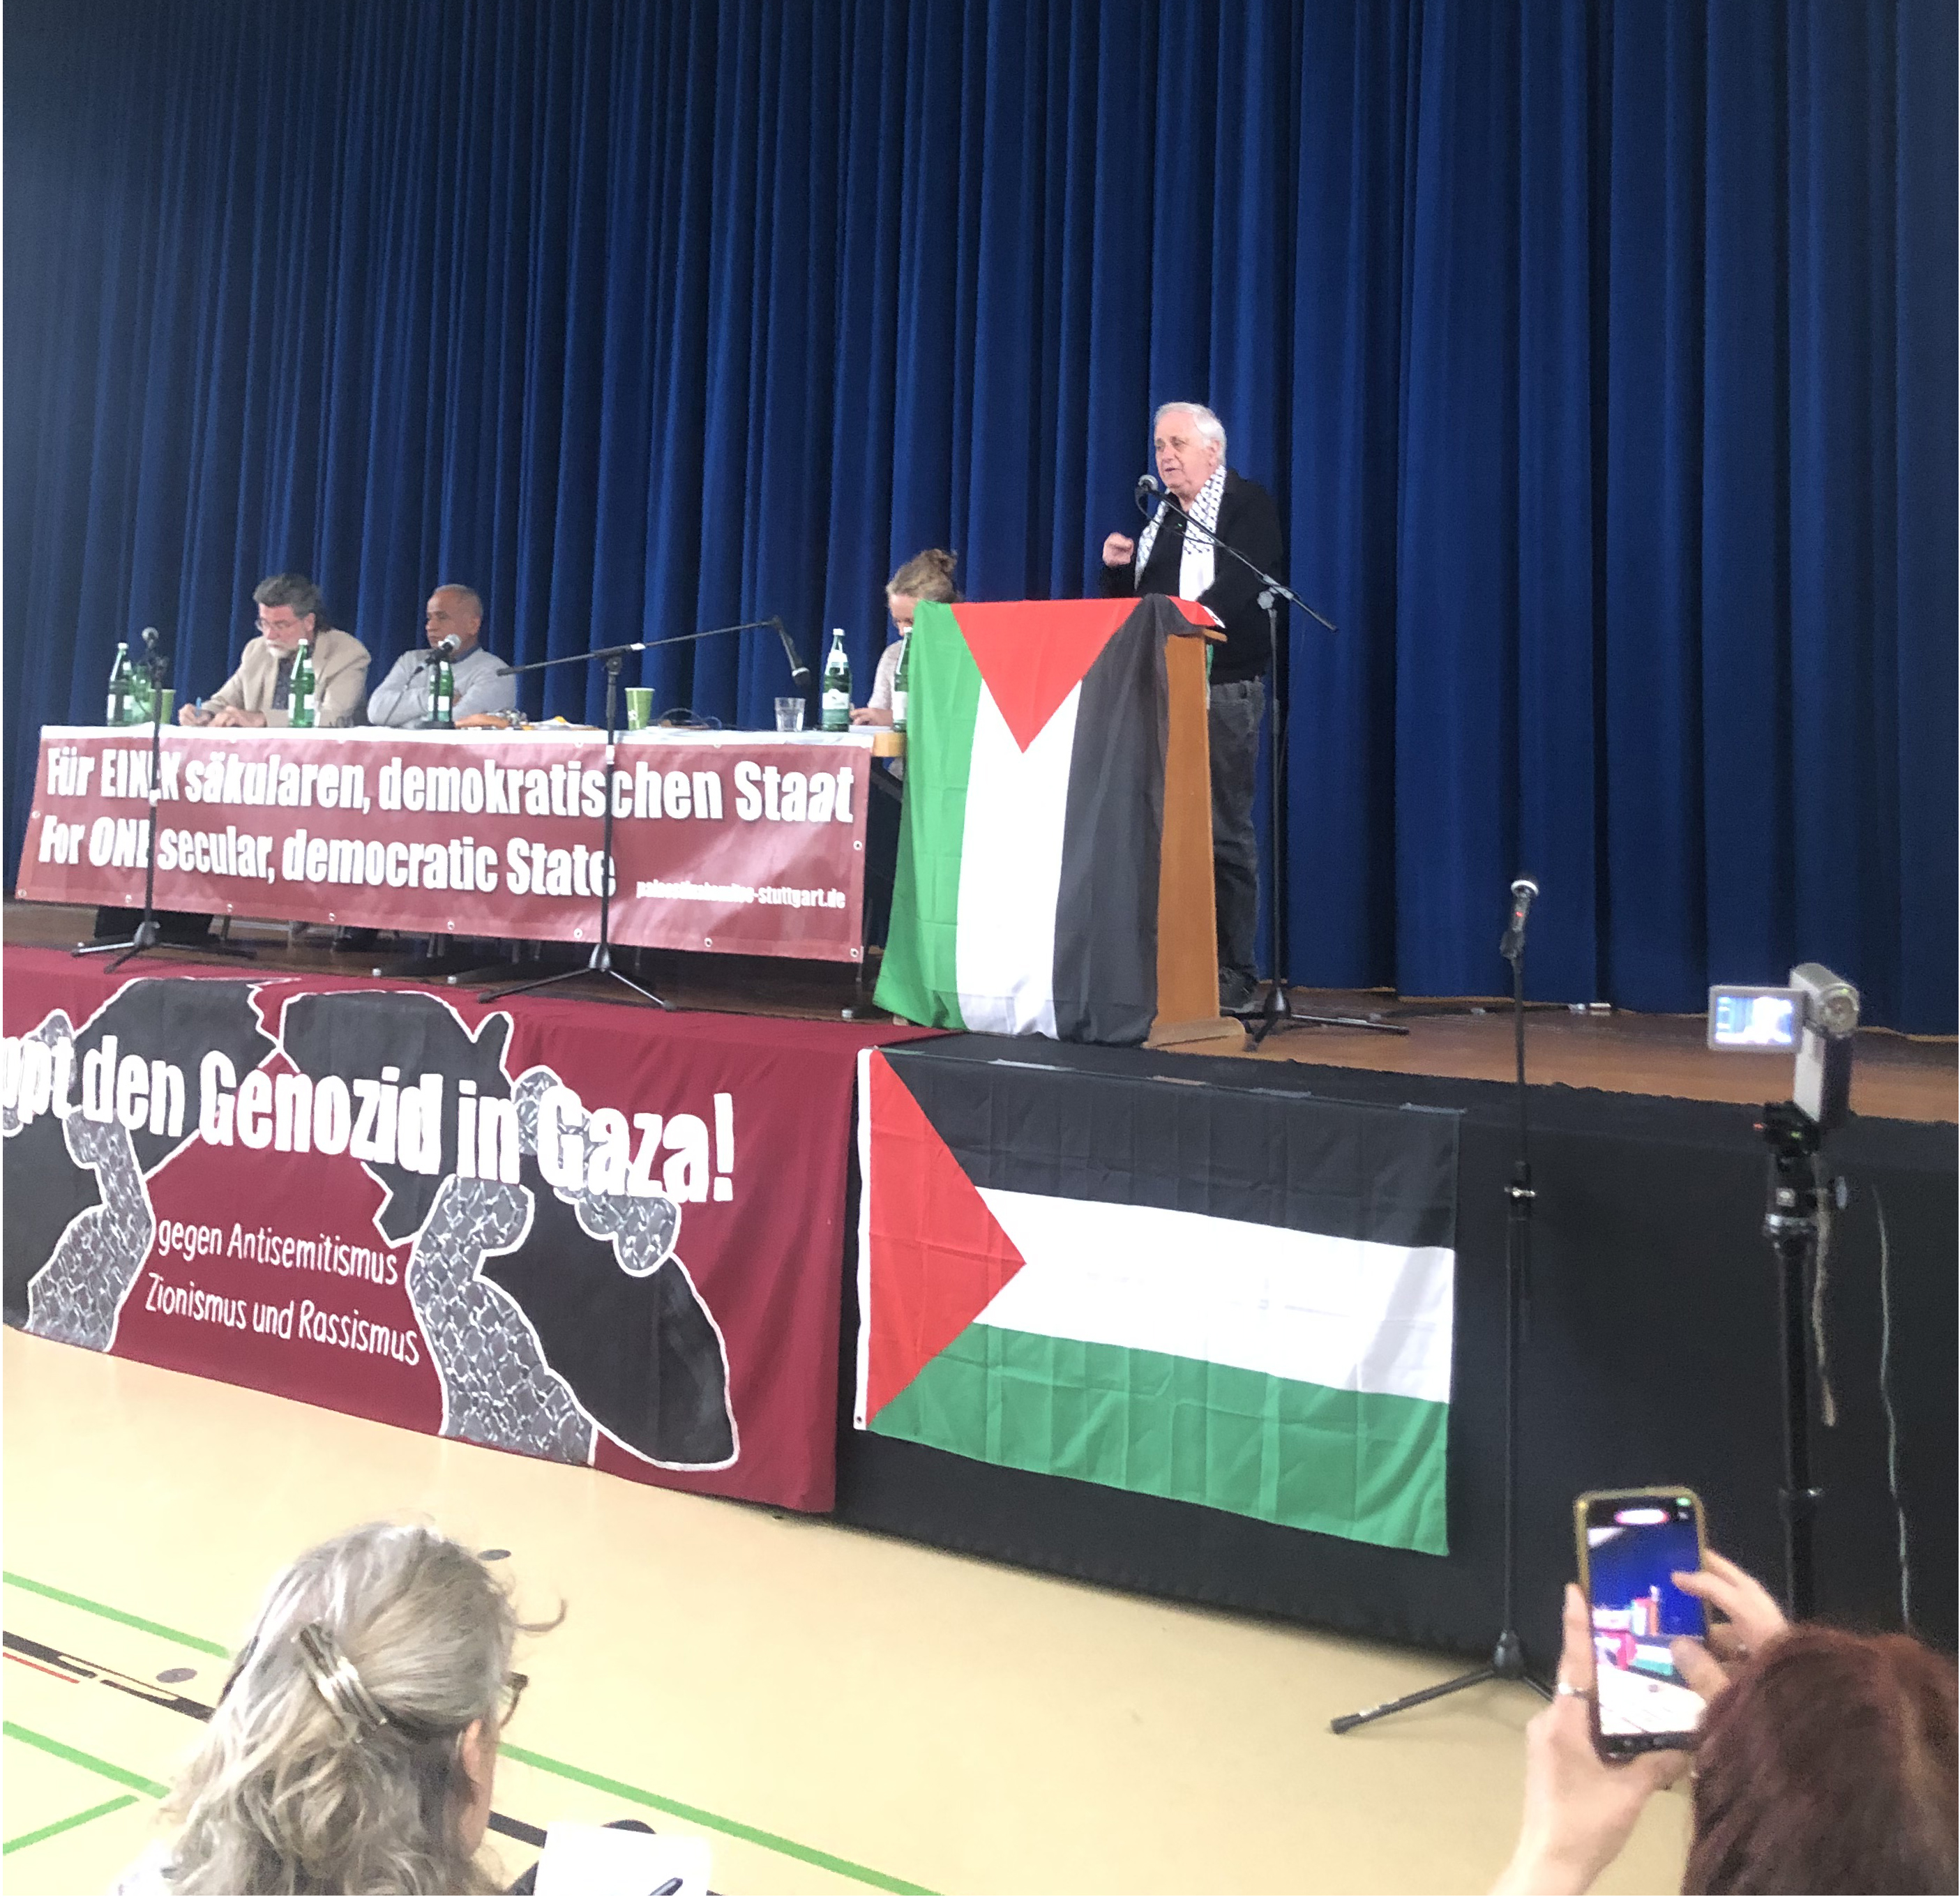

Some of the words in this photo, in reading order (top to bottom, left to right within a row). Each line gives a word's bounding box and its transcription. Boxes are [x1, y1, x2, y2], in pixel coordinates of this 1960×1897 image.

[47, 746, 95, 796] Für
[185, 753, 370, 814] säkularen,
[379, 757, 723, 819] demokratischen
[734, 761, 854, 823] Staat
[38, 815, 85, 864] For
[157, 826, 275, 884] secular,
[282, 829, 497, 892] democratic
[506, 838, 616, 897] State
[82, 1035, 185, 1138] den
[199, 1050, 444, 1174] Genozid
[456, 1079, 520, 1185] in
[536, 1084, 734, 1203] Gaza!
[159, 1220, 223, 1261] gegen
[227, 1223, 399, 1285] Antisemitismus
[145, 1272, 247, 1329] Zionismus
[252, 1300, 294, 1339] und
[299, 1299, 421, 1366] Rassismus
